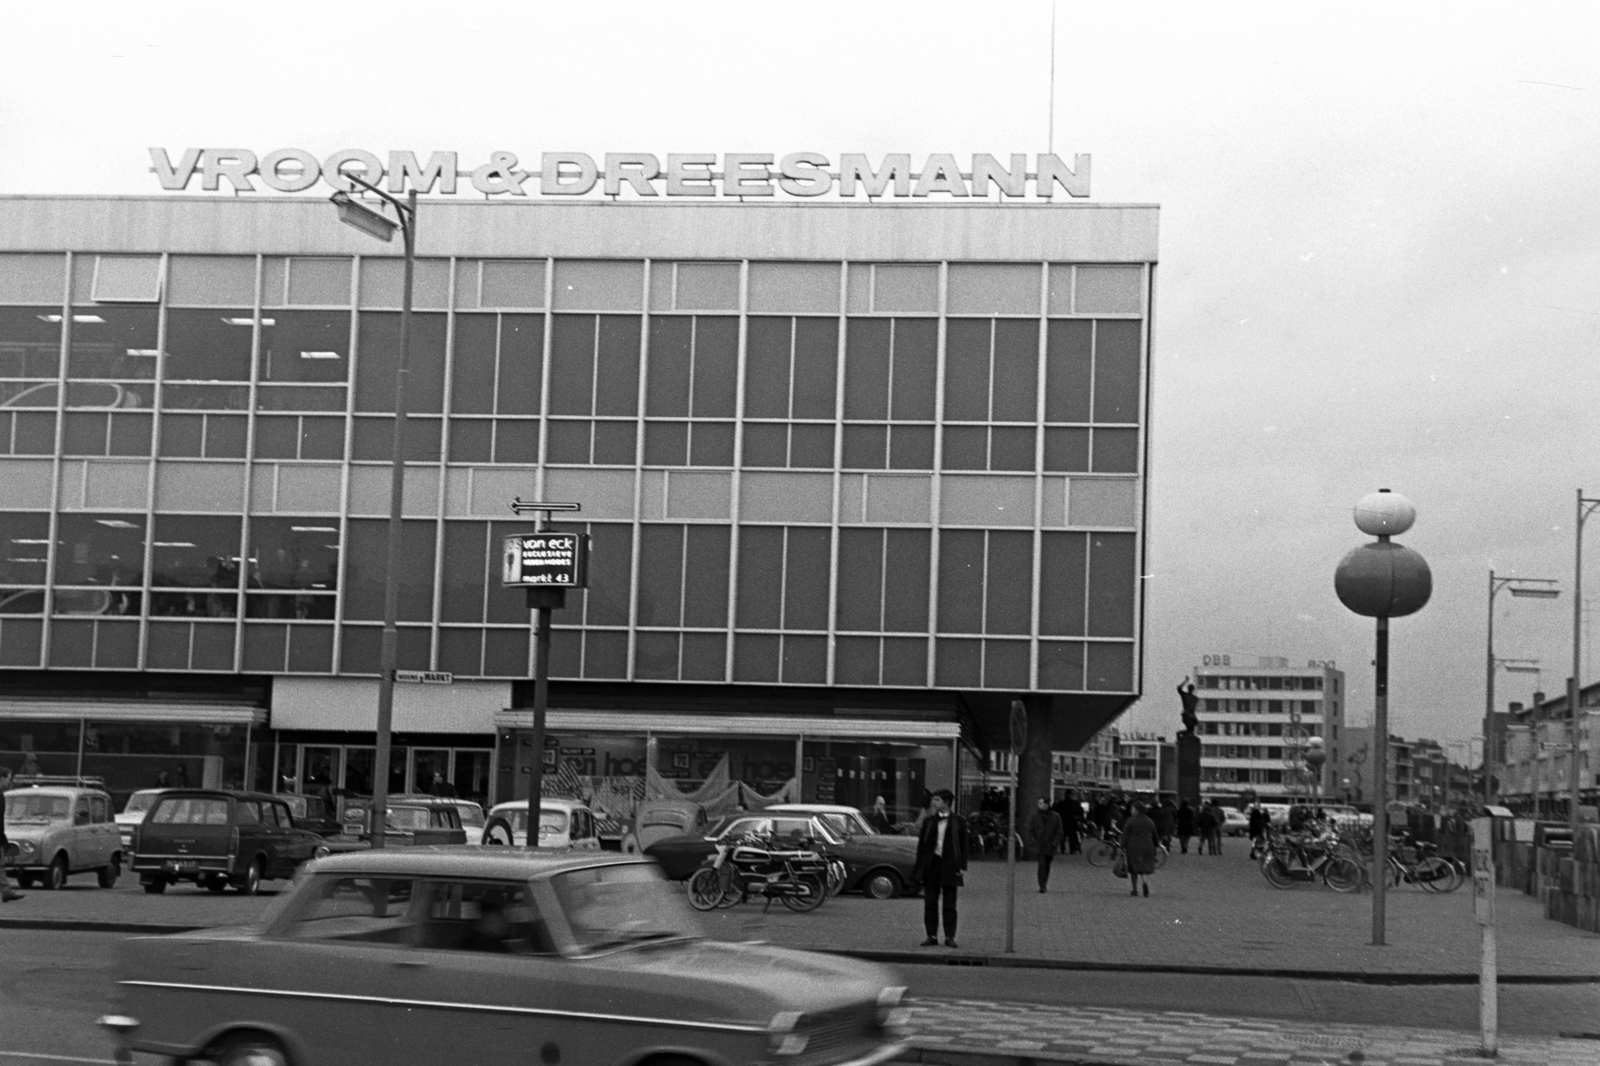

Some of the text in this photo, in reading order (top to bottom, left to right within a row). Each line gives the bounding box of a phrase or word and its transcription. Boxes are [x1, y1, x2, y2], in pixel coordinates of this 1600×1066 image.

[148, 147, 1091, 198] VROOM & DREESMANN
[549, 538, 573, 549] eck
[555, 573, 569, 583] 43
[425, 674, 450, 682] MARKT
